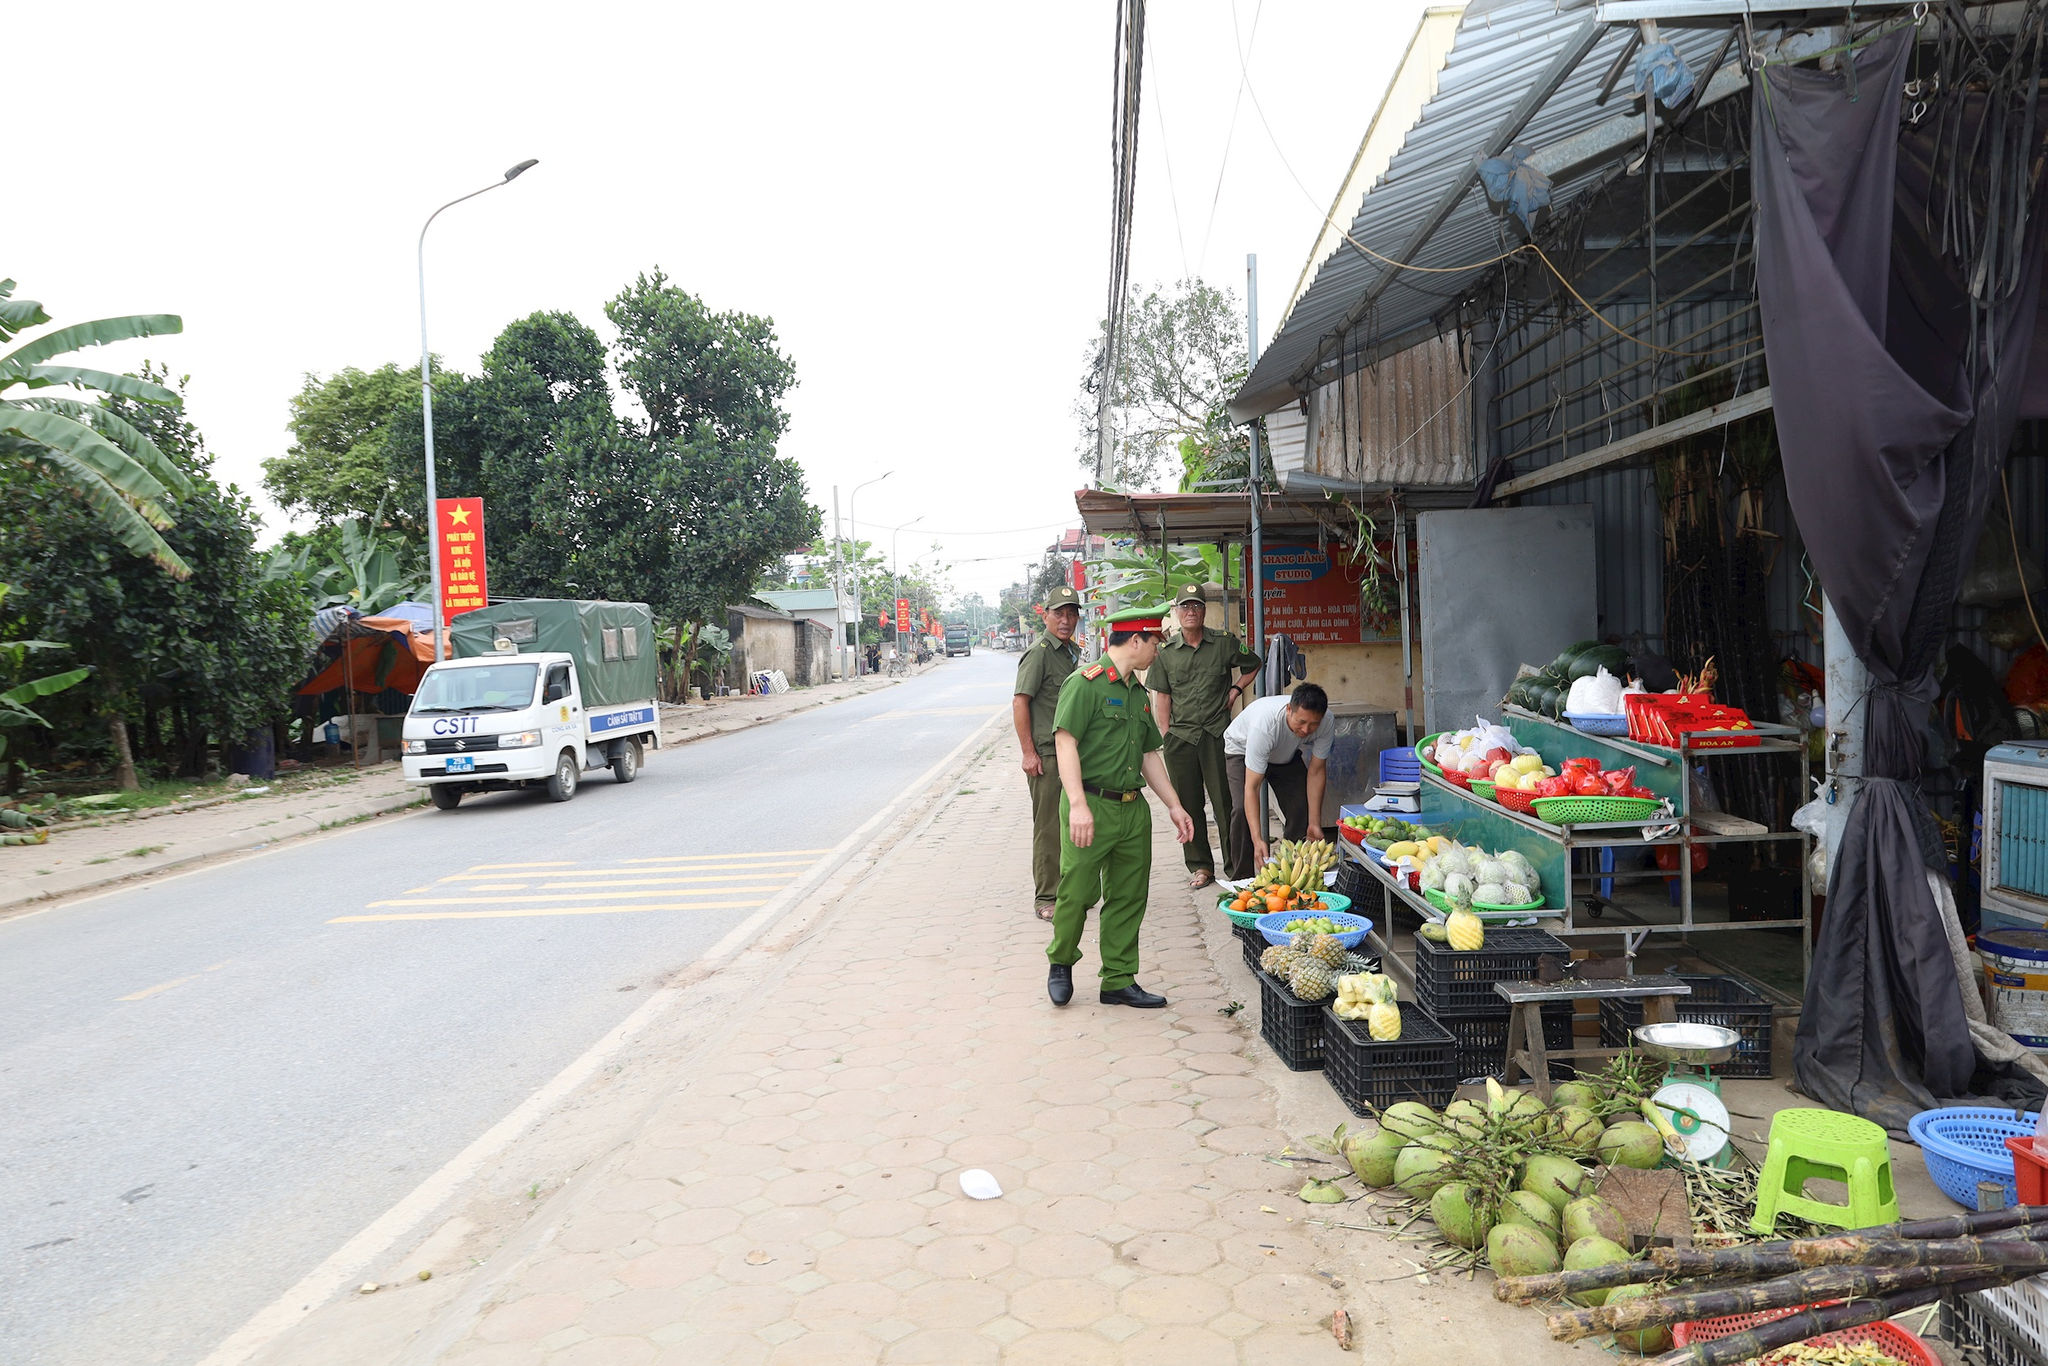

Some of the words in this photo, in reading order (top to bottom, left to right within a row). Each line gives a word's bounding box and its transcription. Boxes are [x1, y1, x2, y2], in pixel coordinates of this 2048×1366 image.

[1275, 569, 1312, 580] STUDIO
[1299, 606, 1308, 614] XE
[1308, 605, 1322, 614] HOA
[1327, 605, 1341, 614] HOA
[1321, 618, 1332, 627] GIA
[433, 717, 479, 735] CSTT
